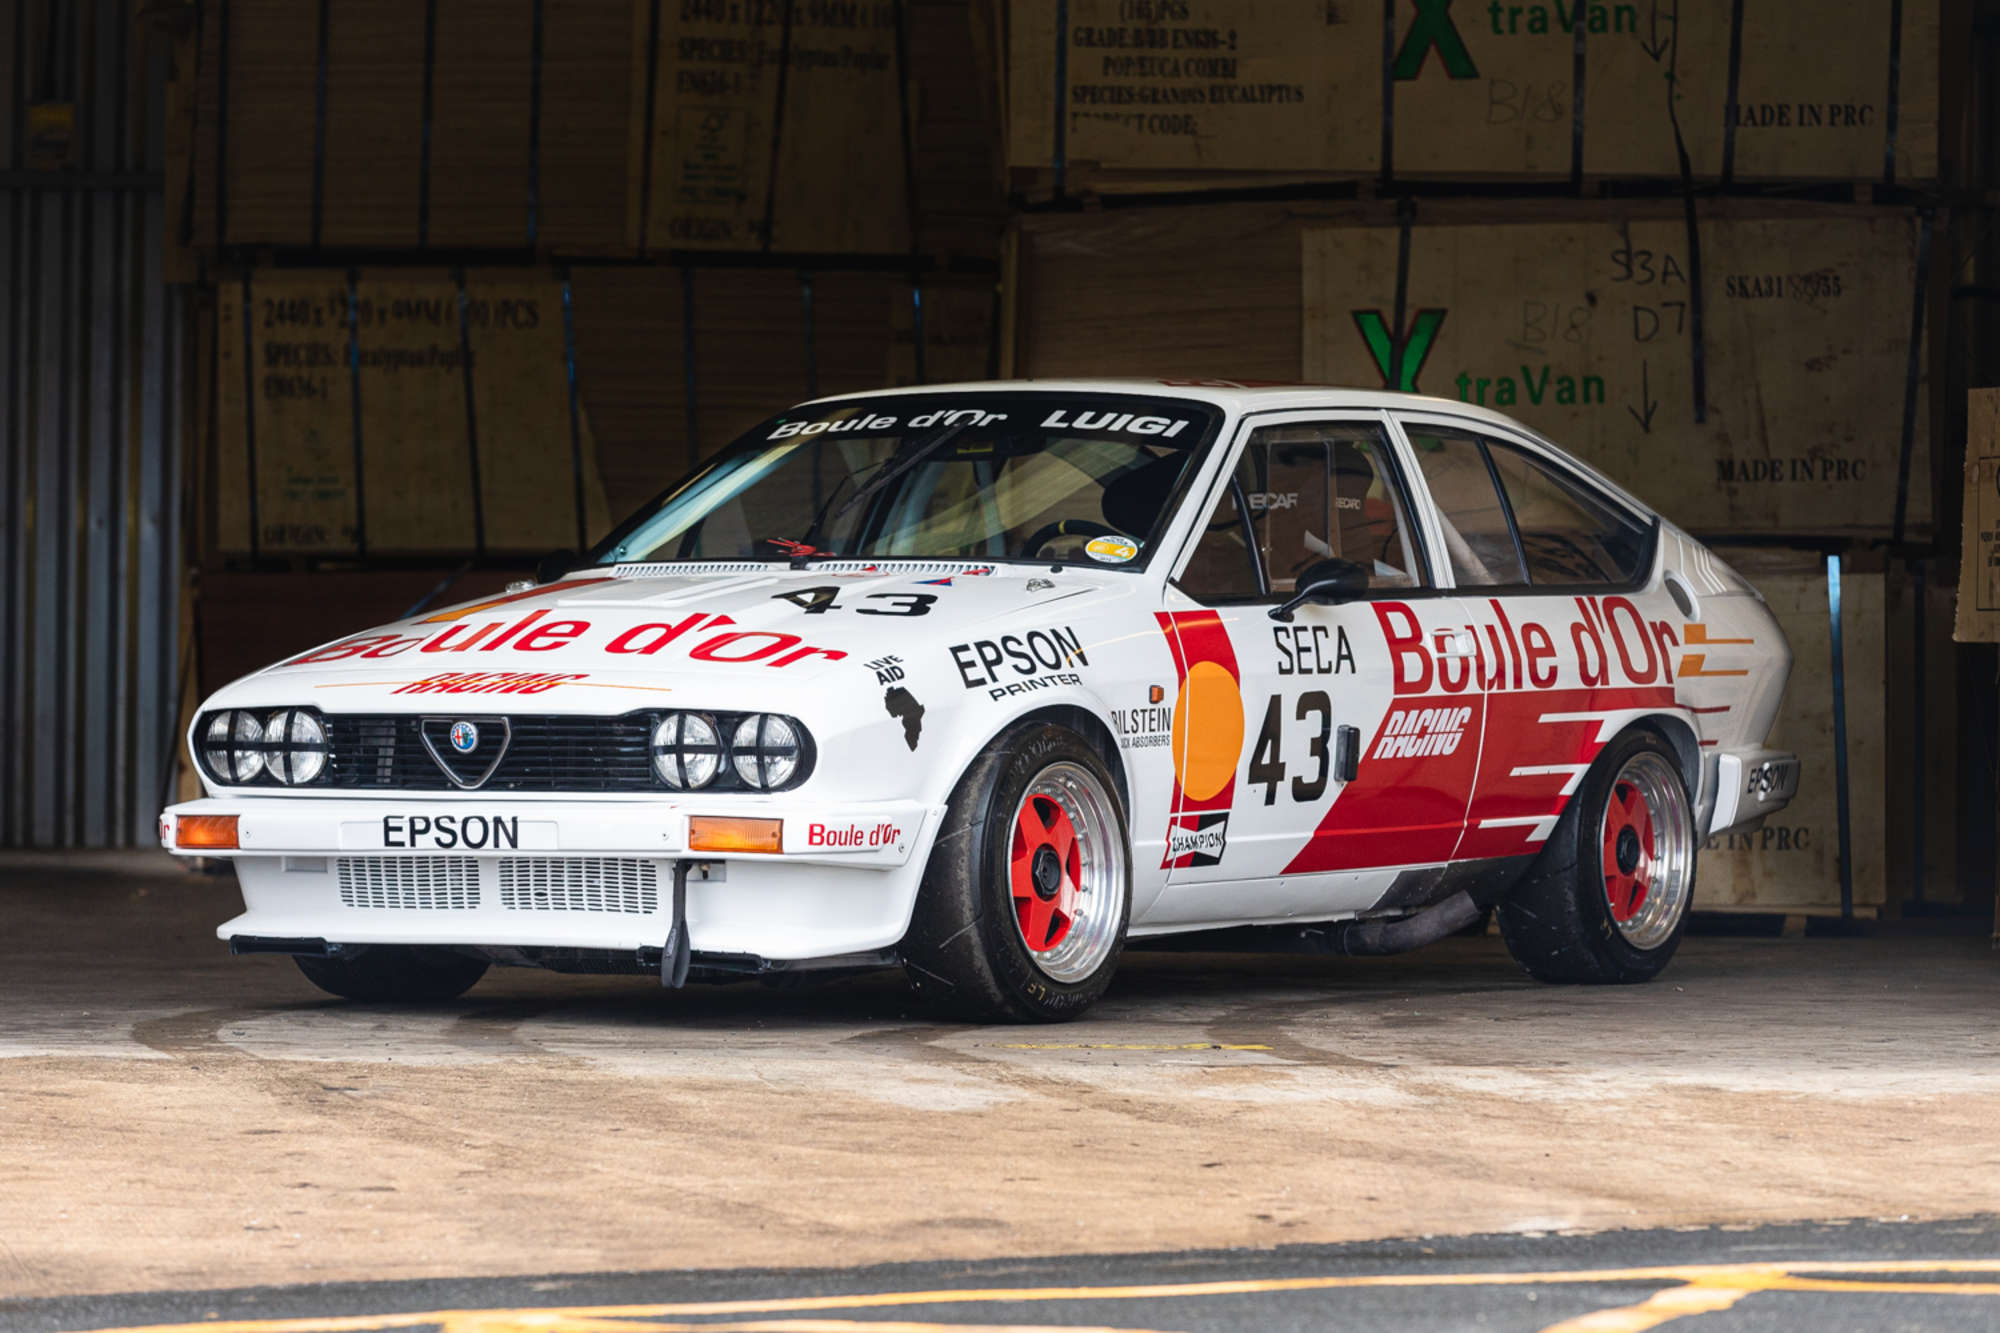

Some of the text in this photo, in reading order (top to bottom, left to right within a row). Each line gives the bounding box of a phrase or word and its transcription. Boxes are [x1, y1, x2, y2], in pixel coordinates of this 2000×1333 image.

[766, 408, 1008, 441] Boule d'Or
[1040, 409, 1190, 438] LUIGI
[1716, 459, 1866, 482] MADE IN PRC
[770, 585, 939, 617] 43
[285, 608, 849, 668] Boule d'Or
[1272, 625, 1357, 676] SECA
[1371, 596, 1680, 696] Boule d'Or
[863, 655, 905, 671] LIVE
[948, 626, 1090, 690] EPSON
[389, 672, 592, 695] RACING
[875, 665, 906, 686] AID
[988, 673, 1084, 702] PRINTER
[1132, 733, 1171, 749] ABSORBERS
[1372, 706, 1473, 760] RACING
[1247, 690, 1332, 807] 43
[1747, 764, 1789, 795] EPSON
[383, 815, 519, 850] EPSON
[808, 823, 901, 847] Boule d'Or
[1171, 831, 1224, 852] CHAMPION
[1762, 826, 1810, 851] PRC
